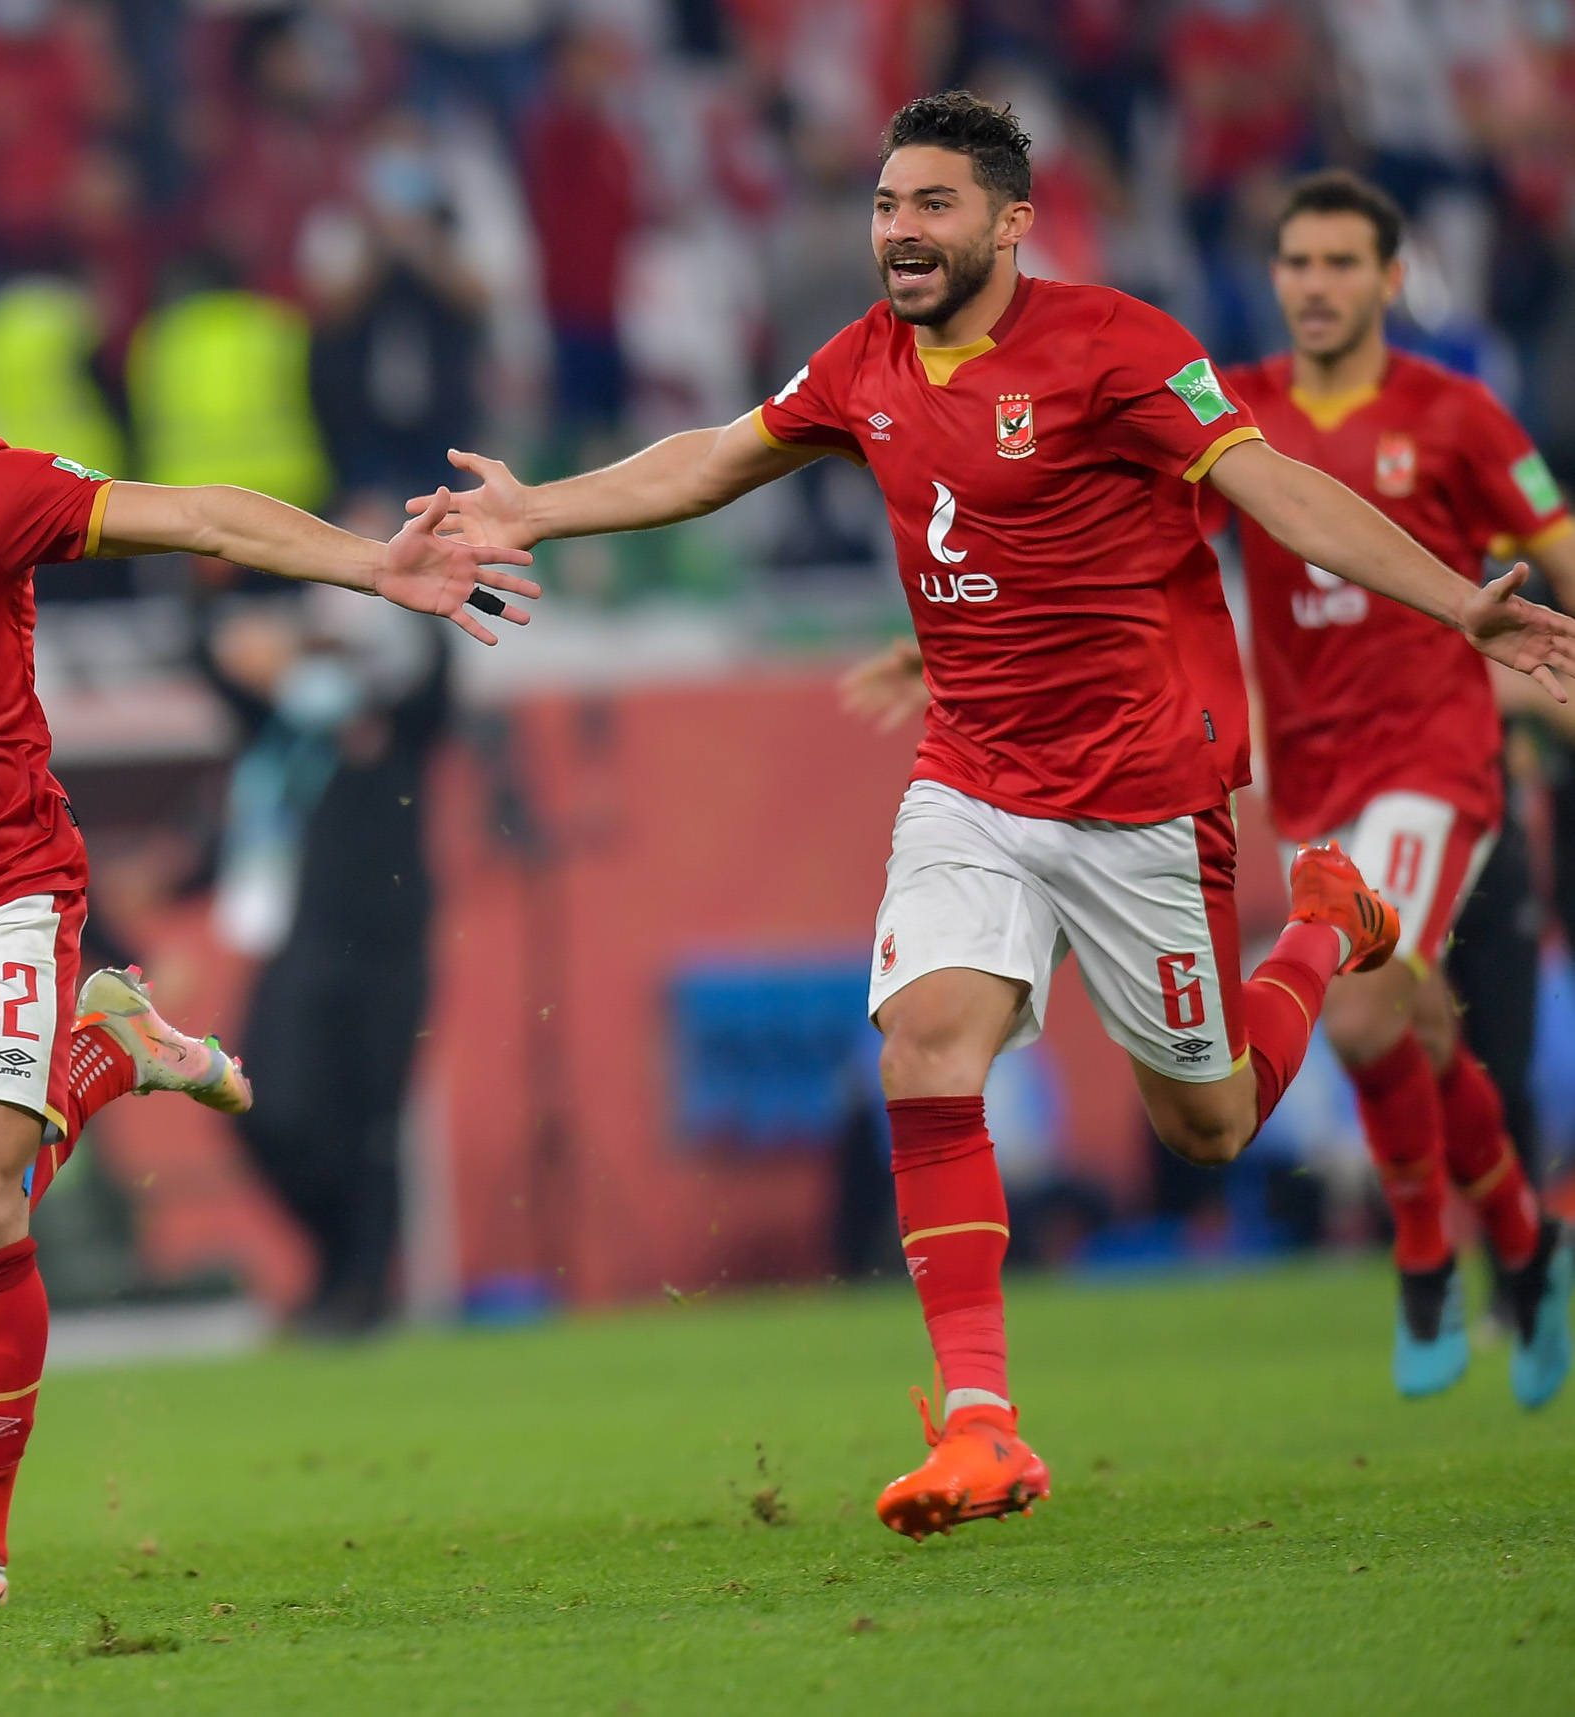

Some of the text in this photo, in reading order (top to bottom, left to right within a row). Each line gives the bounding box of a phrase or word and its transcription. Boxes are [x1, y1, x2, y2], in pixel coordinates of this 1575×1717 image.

[920, 573, 999, 604] we
[1386, 831, 1423, 896] 8
[1156, 952, 1205, 1030] 6
[1176, 1054, 1211, 1064] umbro
